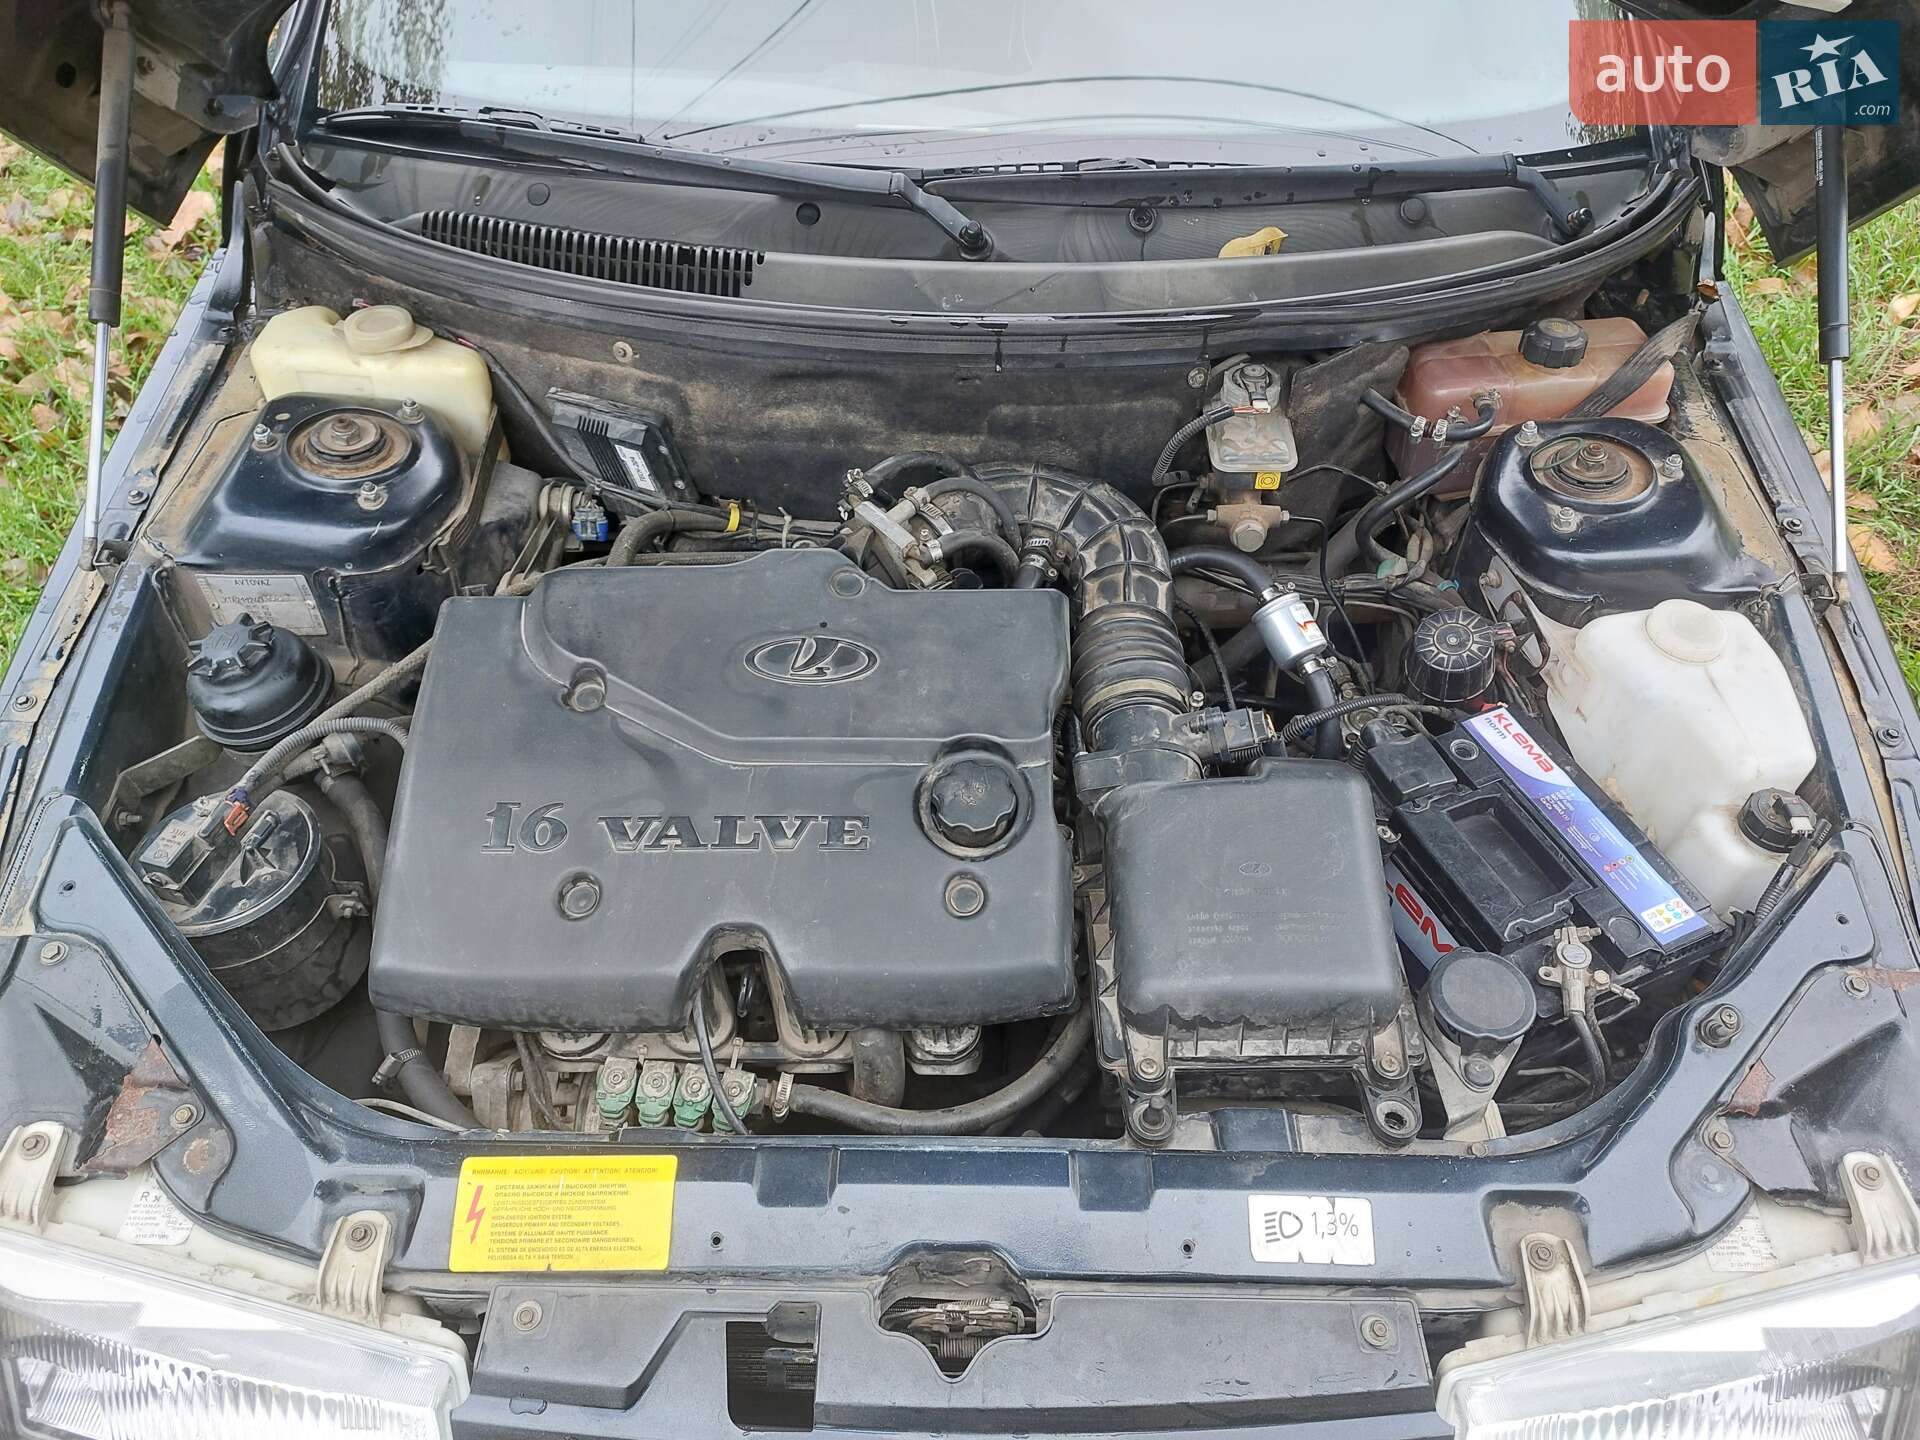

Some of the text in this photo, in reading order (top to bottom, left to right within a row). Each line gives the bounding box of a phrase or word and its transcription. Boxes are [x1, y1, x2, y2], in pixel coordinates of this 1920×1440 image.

[1485, 717, 1508, 741] norm
[480, 801, 870, 854] 16 VALVE
[1311, 1211, 1359, 1239] 1,3%
